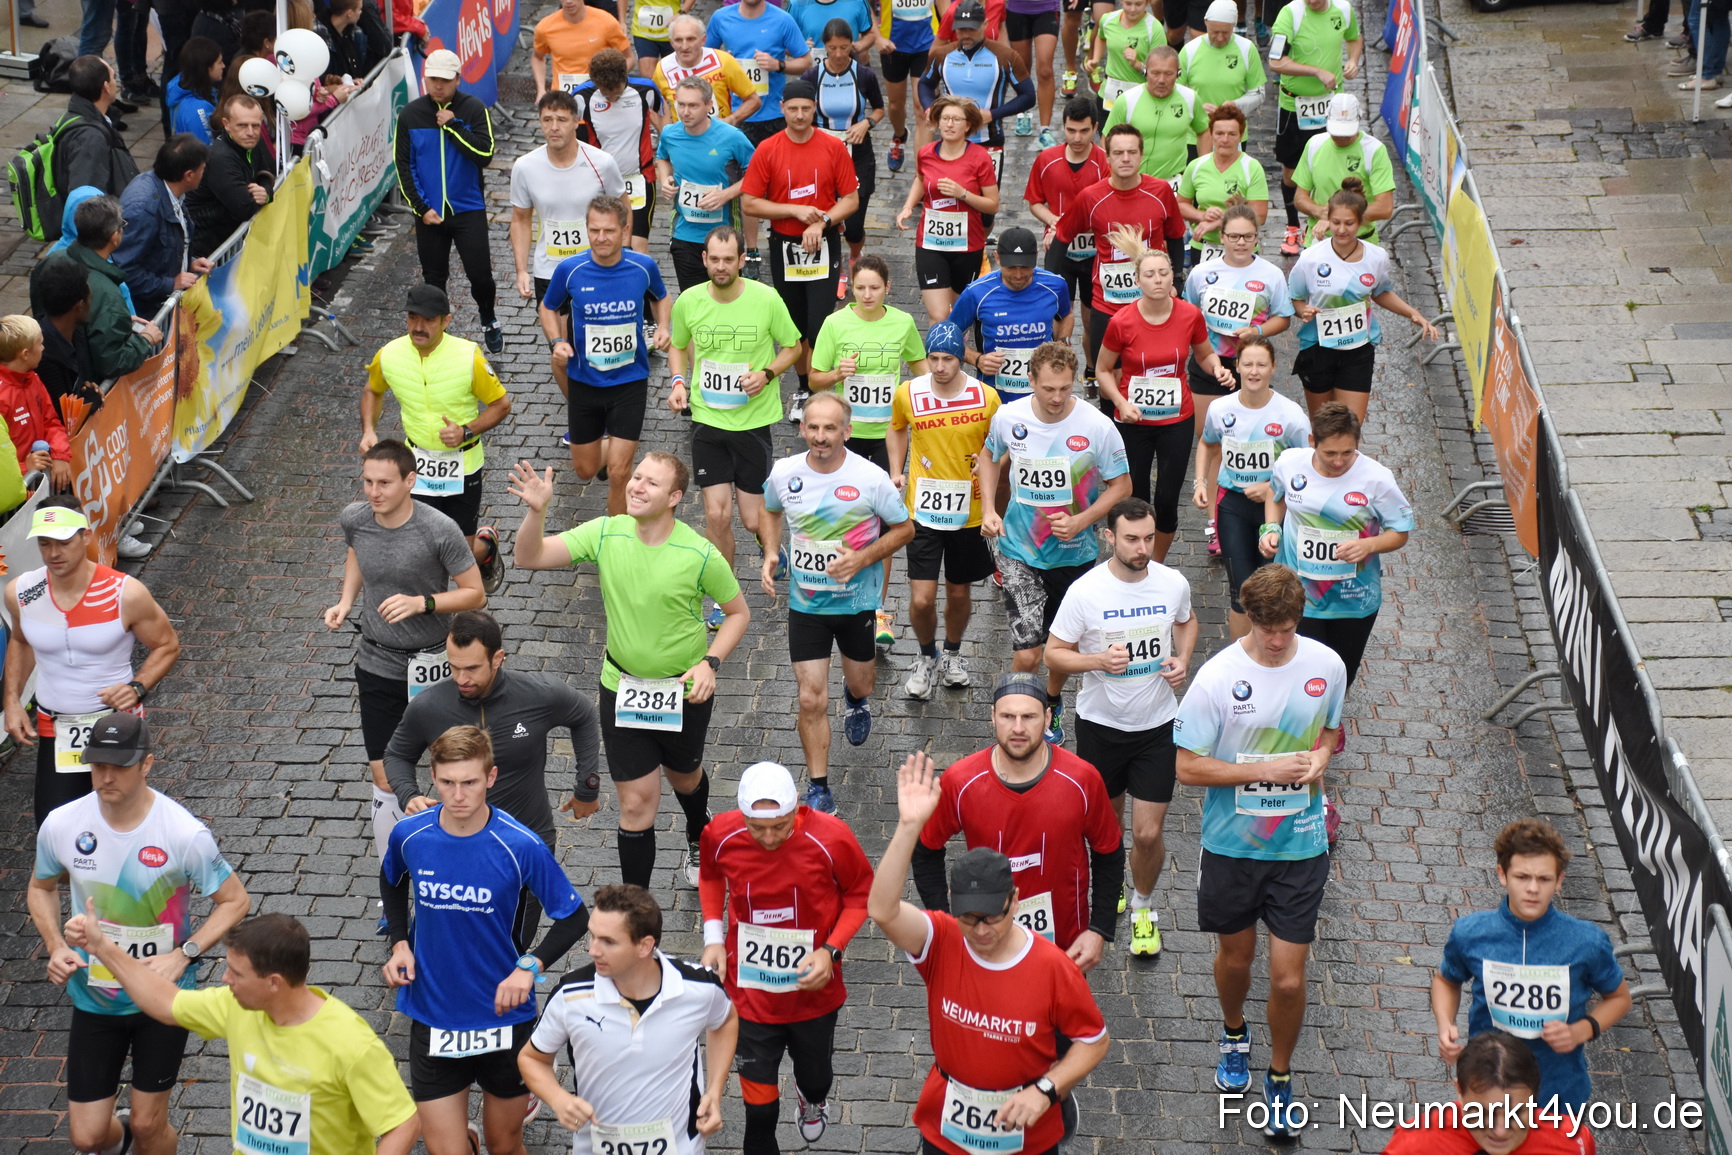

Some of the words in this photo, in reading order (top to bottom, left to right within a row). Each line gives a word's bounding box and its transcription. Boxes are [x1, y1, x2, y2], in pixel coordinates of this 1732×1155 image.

[649, 14, 664, 27] 70
[458, 2, 492, 66] Hervis
[683, 191, 707, 208] 21
[928, 219, 962, 236] 2581
[552, 230, 582, 245] 213
[935, 238, 954, 246] Carina
[1104, 273, 1136, 288] 246
[584, 301, 636, 315] SYSCAD
[1208, 297, 1250, 320] 2682
[996, 322, 1046, 336] SYSCAD
[1216, 320, 1233, 329] Lena
[1323, 313, 1363, 336] 2116
[592, 335, 633, 353] 2568
[696, 325, 757, 350] OPF
[1337, 338, 1354, 346] Rosa
[704, 371, 742, 392] 3014
[849, 385, 892, 404] 3015
[1134, 388, 1175, 406] 2521
[915, 418, 947, 430] MAX
[951, 412, 987, 426] BÖGL
[416, 458, 459, 478] 2562
[1226, 450, 1270, 469] 2640
[1019, 468, 1066, 488] 2439
[1235, 474, 1258, 482] Peggy
[920, 490, 966, 511] 2817
[1030, 491, 1055, 501] Tobias
[930, 515, 953, 524] Stefan
[803, 574, 828, 584] Hubert
[18, 578, 49, 600] COMPRE
[1103, 605, 1167, 620] PUMA
[1108, 638, 1161, 662] 446
[623, 688, 677, 710] 2384
[1233, 703, 1256, 711] PARTL
[636, 713, 663, 722] Martin
[1260, 798, 1286, 808] Peter
[74, 857, 97, 866] PARTL
[419, 881, 492, 904] SYSCAD
[114, 942, 158, 959] 49
[745, 941, 806, 968] 2462
[759, 972, 790, 984] Daniel
[1493, 981, 1561, 1010] 2286
[942, 997, 1022, 1035] NEUMARKT
[1508, 1015, 1544, 1028] Robert
[439, 1028, 503, 1053] 2051
[242, 1096, 302, 1137] 2037
[951, 1099, 1016, 1133] 264
[247, 1134, 289, 1154] Thorsten
[963, 1134, 999, 1149] Jürgen
